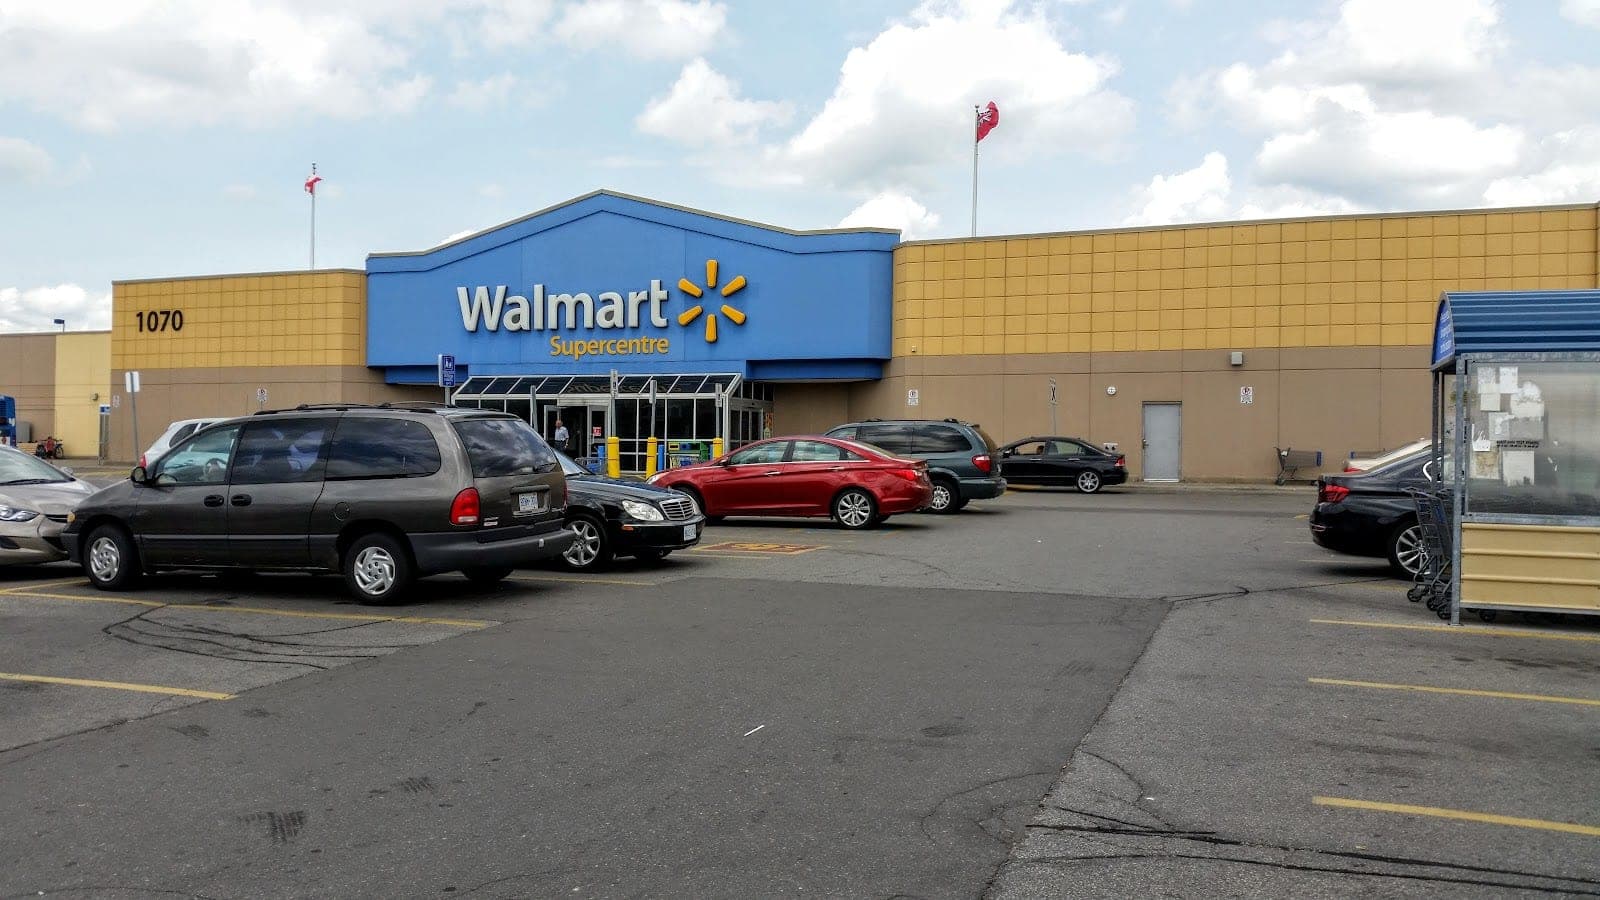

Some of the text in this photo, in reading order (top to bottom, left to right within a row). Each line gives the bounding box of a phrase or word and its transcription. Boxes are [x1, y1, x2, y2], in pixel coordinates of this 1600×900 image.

[457, 280, 669, 331] Walmart
[136, 310, 183, 332] 1070
[550, 336, 669, 360] Supercentre
